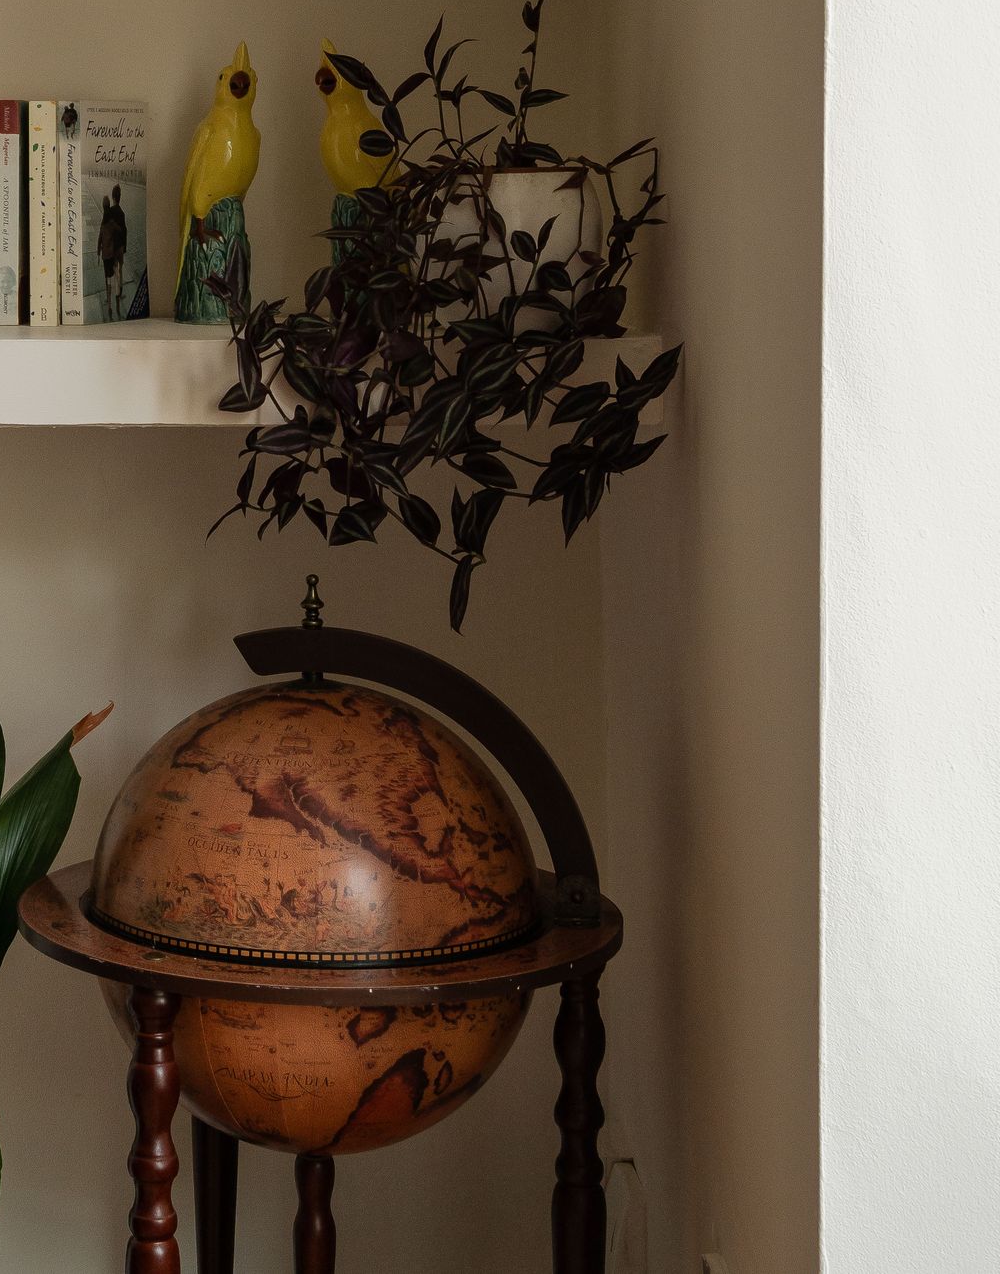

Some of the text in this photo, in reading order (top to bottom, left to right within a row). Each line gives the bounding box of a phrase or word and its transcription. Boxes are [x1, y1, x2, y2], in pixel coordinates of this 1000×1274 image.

[86, 118, 144, 138] Farewell to the
[67, 143, 78, 186] Farewell
[95, 143, 137, 165] East End
[68, 196, 76, 207] the
[67, 209, 77, 233] East
[66, 235, 78, 257] End
